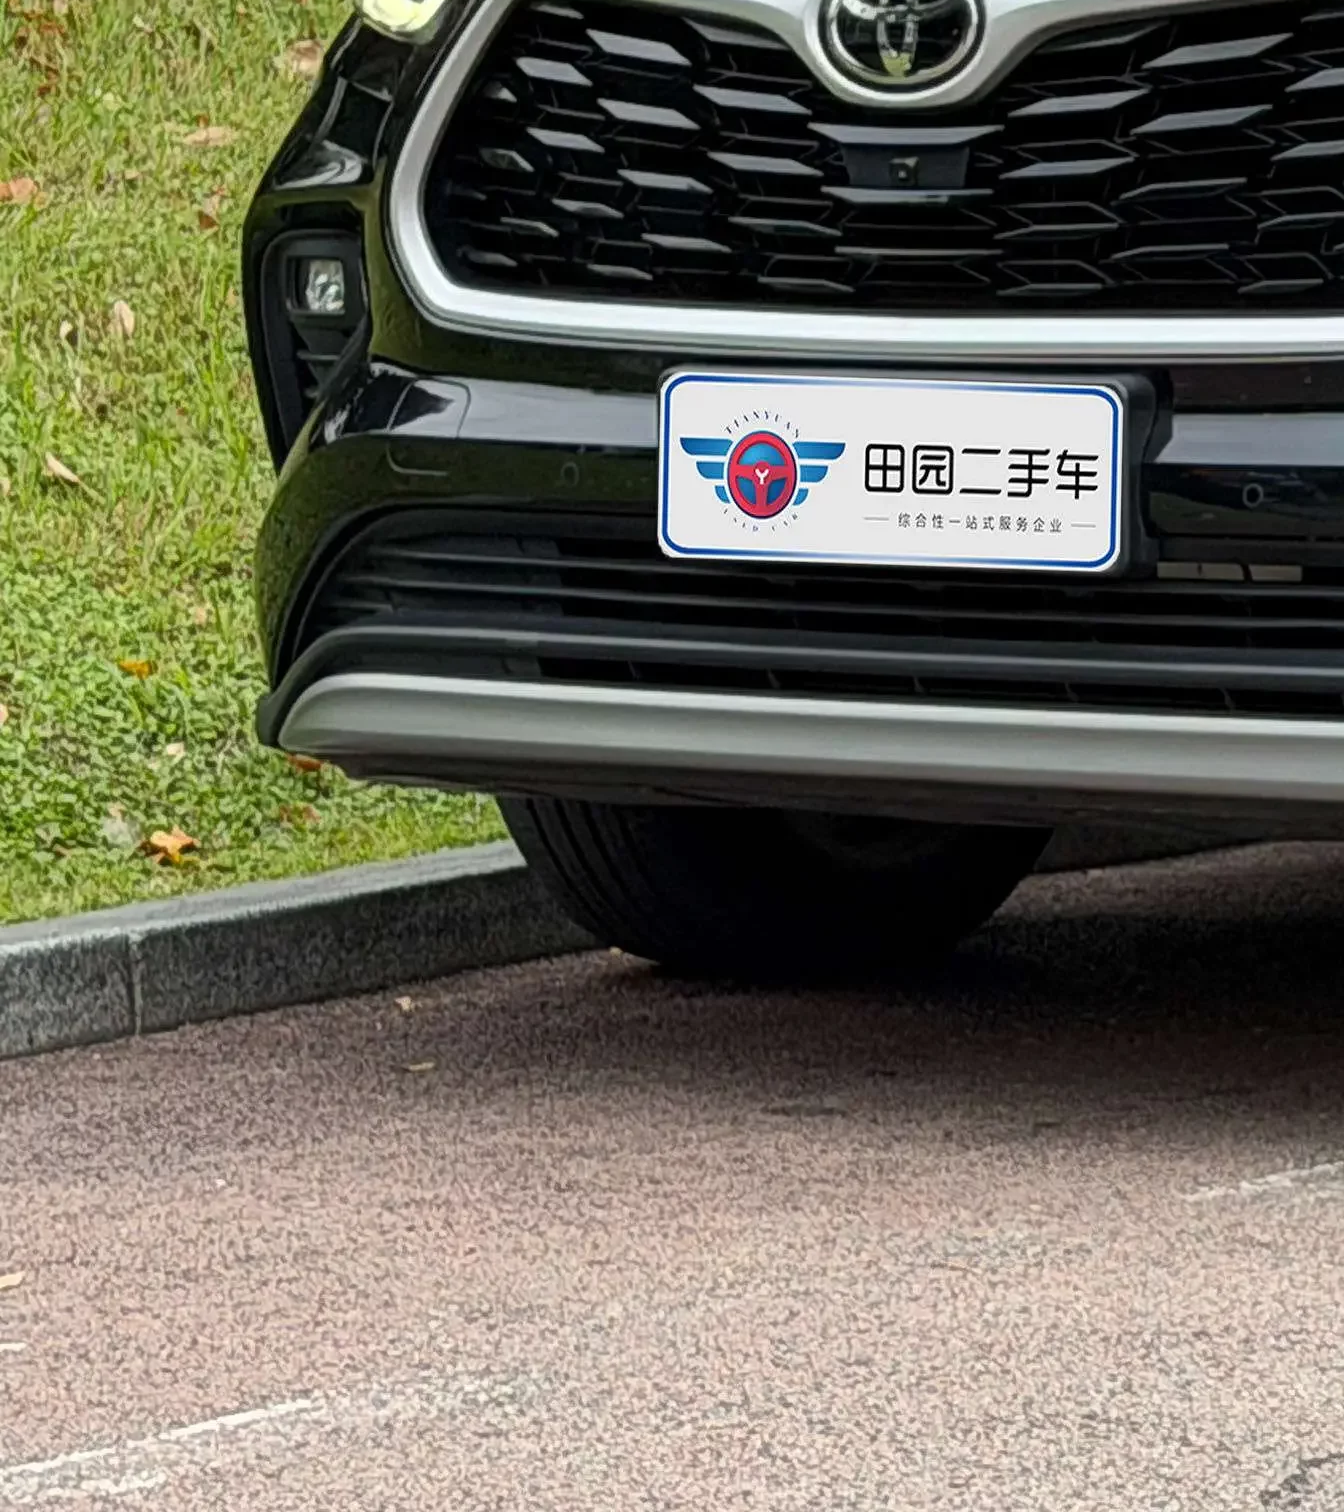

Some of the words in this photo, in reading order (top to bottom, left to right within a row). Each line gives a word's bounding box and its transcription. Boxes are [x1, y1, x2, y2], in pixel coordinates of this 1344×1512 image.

[865, 444, 1099, 499] 田园二手车
[898, 512, 1062, 533] 综合性一站式服务企业
